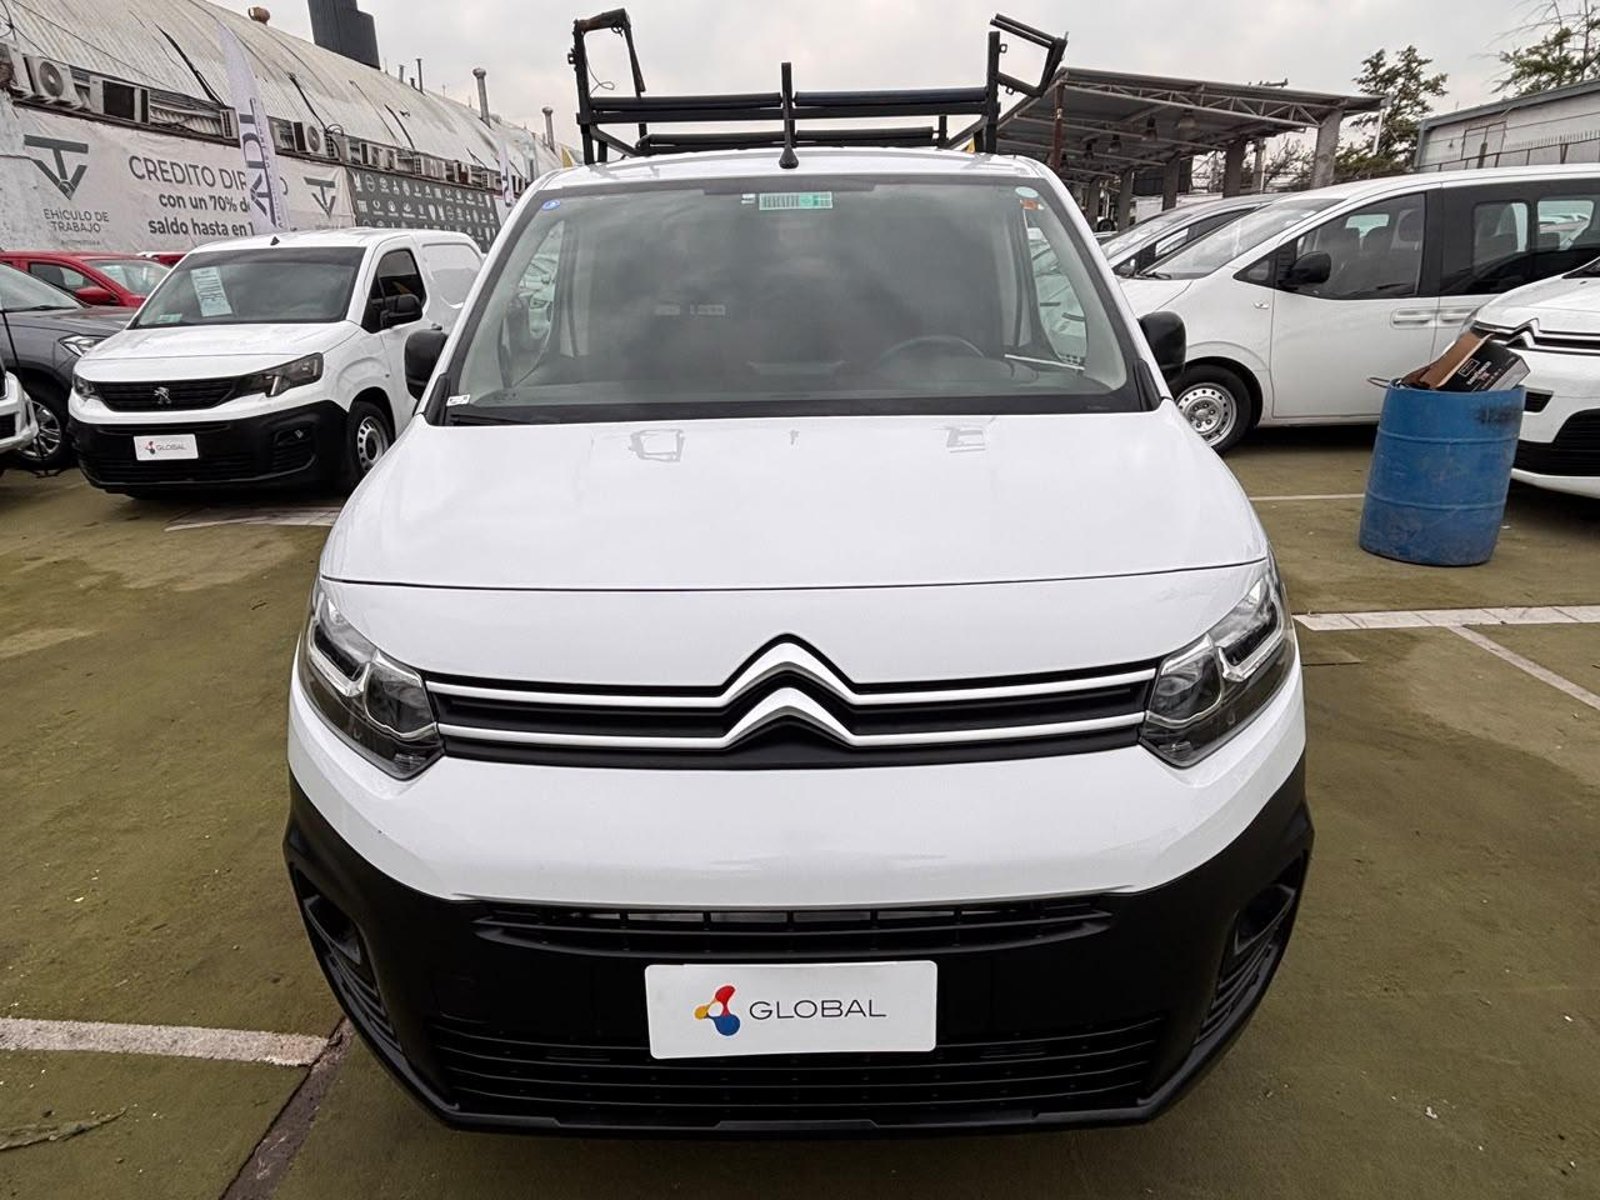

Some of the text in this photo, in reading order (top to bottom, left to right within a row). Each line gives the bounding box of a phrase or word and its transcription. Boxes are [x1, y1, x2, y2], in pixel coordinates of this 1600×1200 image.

[128, 155, 216, 188] CREDITO
[159, 193, 250, 213] con un 70% d
[51, 220, 101, 233] TRABAJO
[94, 211, 109, 222] DE
[148, 216, 189, 235] saldo
[190, 217, 229, 236] hasta
[231, 223, 247, 237] en
[749, 999, 887, 1020] GLOBAL
